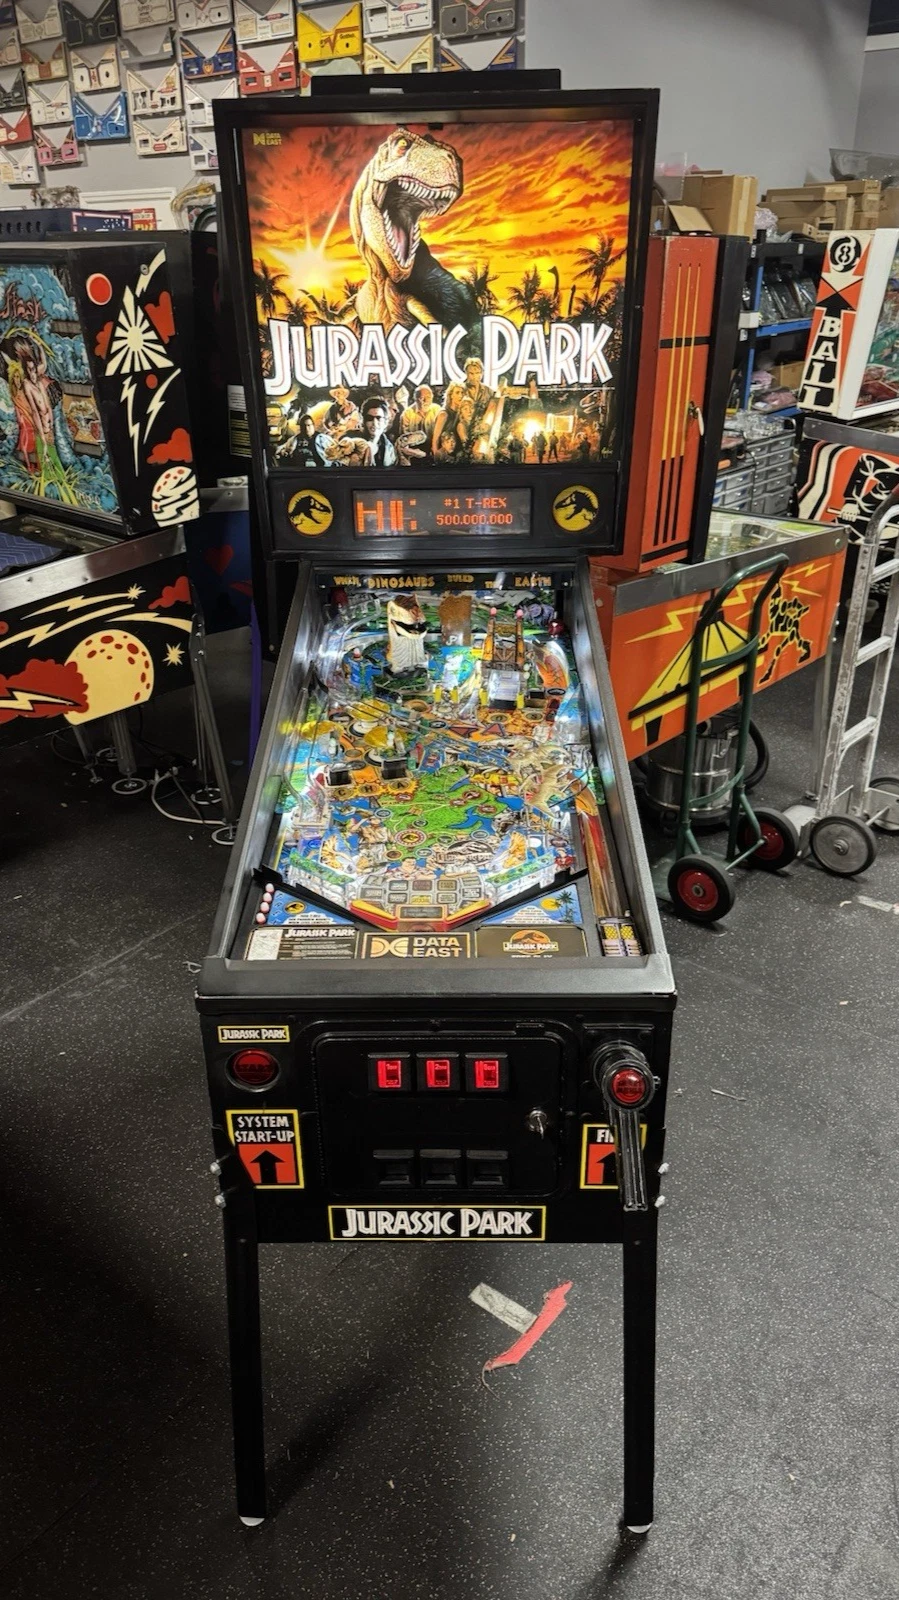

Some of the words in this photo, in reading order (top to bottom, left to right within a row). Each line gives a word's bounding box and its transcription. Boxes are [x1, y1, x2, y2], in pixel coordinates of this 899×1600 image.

[264, 319, 468, 395] JURASSIC
[483, 315, 613, 392] PARK
[797, 316, 841, 415] BALL
[444, 498, 460, 509] #1
[465, 497, 507, 509] T-REX
[367, 576, 435, 589] DINOSAURS
[285, 929, 327, 938] JURASSIC
[328, 929, 355, 938] PARK
[413, 937, 460, 947] DATA
[505, 942, 537, 950] JURASSIC
[537, 942, 558, 950] PARK
[412, 947, 462, 958] EAST
[222, 1028, 260, 1040] JURASSIC
[261, 1028, 286, 1040] PARK
[237, 1116, 289, 1128] SYSTEM
[234, 1130, 295, 1143] START-UP
[342, 1208, 455, 1237] JURASSIC
[460, 1208, 534, 1237] PARK
